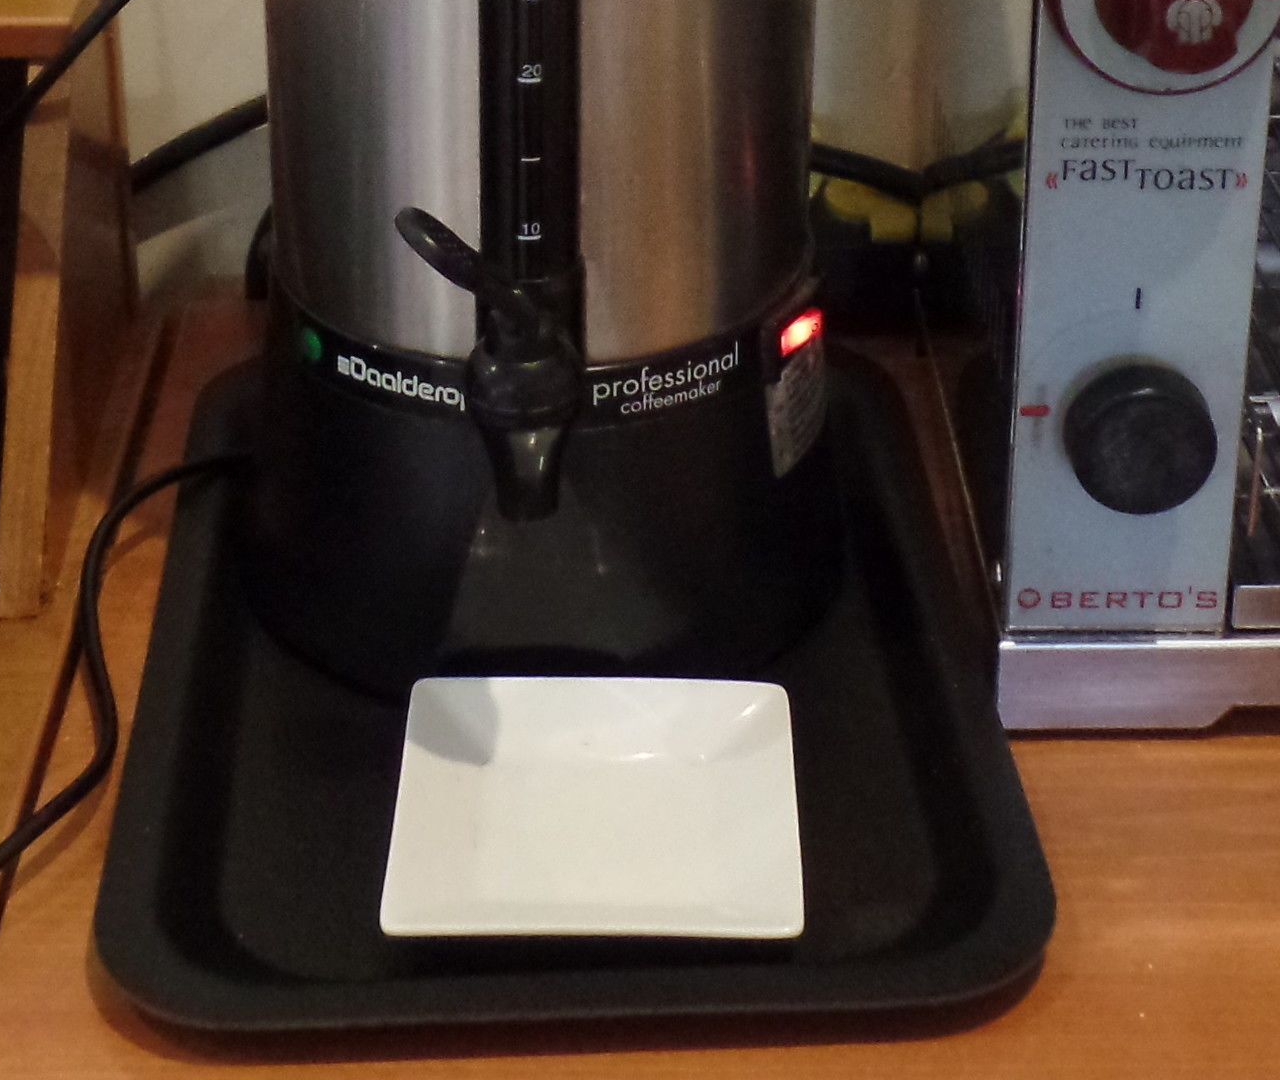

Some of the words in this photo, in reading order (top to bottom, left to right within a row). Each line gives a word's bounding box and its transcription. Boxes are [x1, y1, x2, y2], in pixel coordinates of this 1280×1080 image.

[521, 64, 542, 78] 20
[521, 222, 541, 235] 10
[592, 340, 739, 406] professional
[620, 378, 721, 414] coffeemaker
[1050, 585, 1218, 609] BERTO'S
